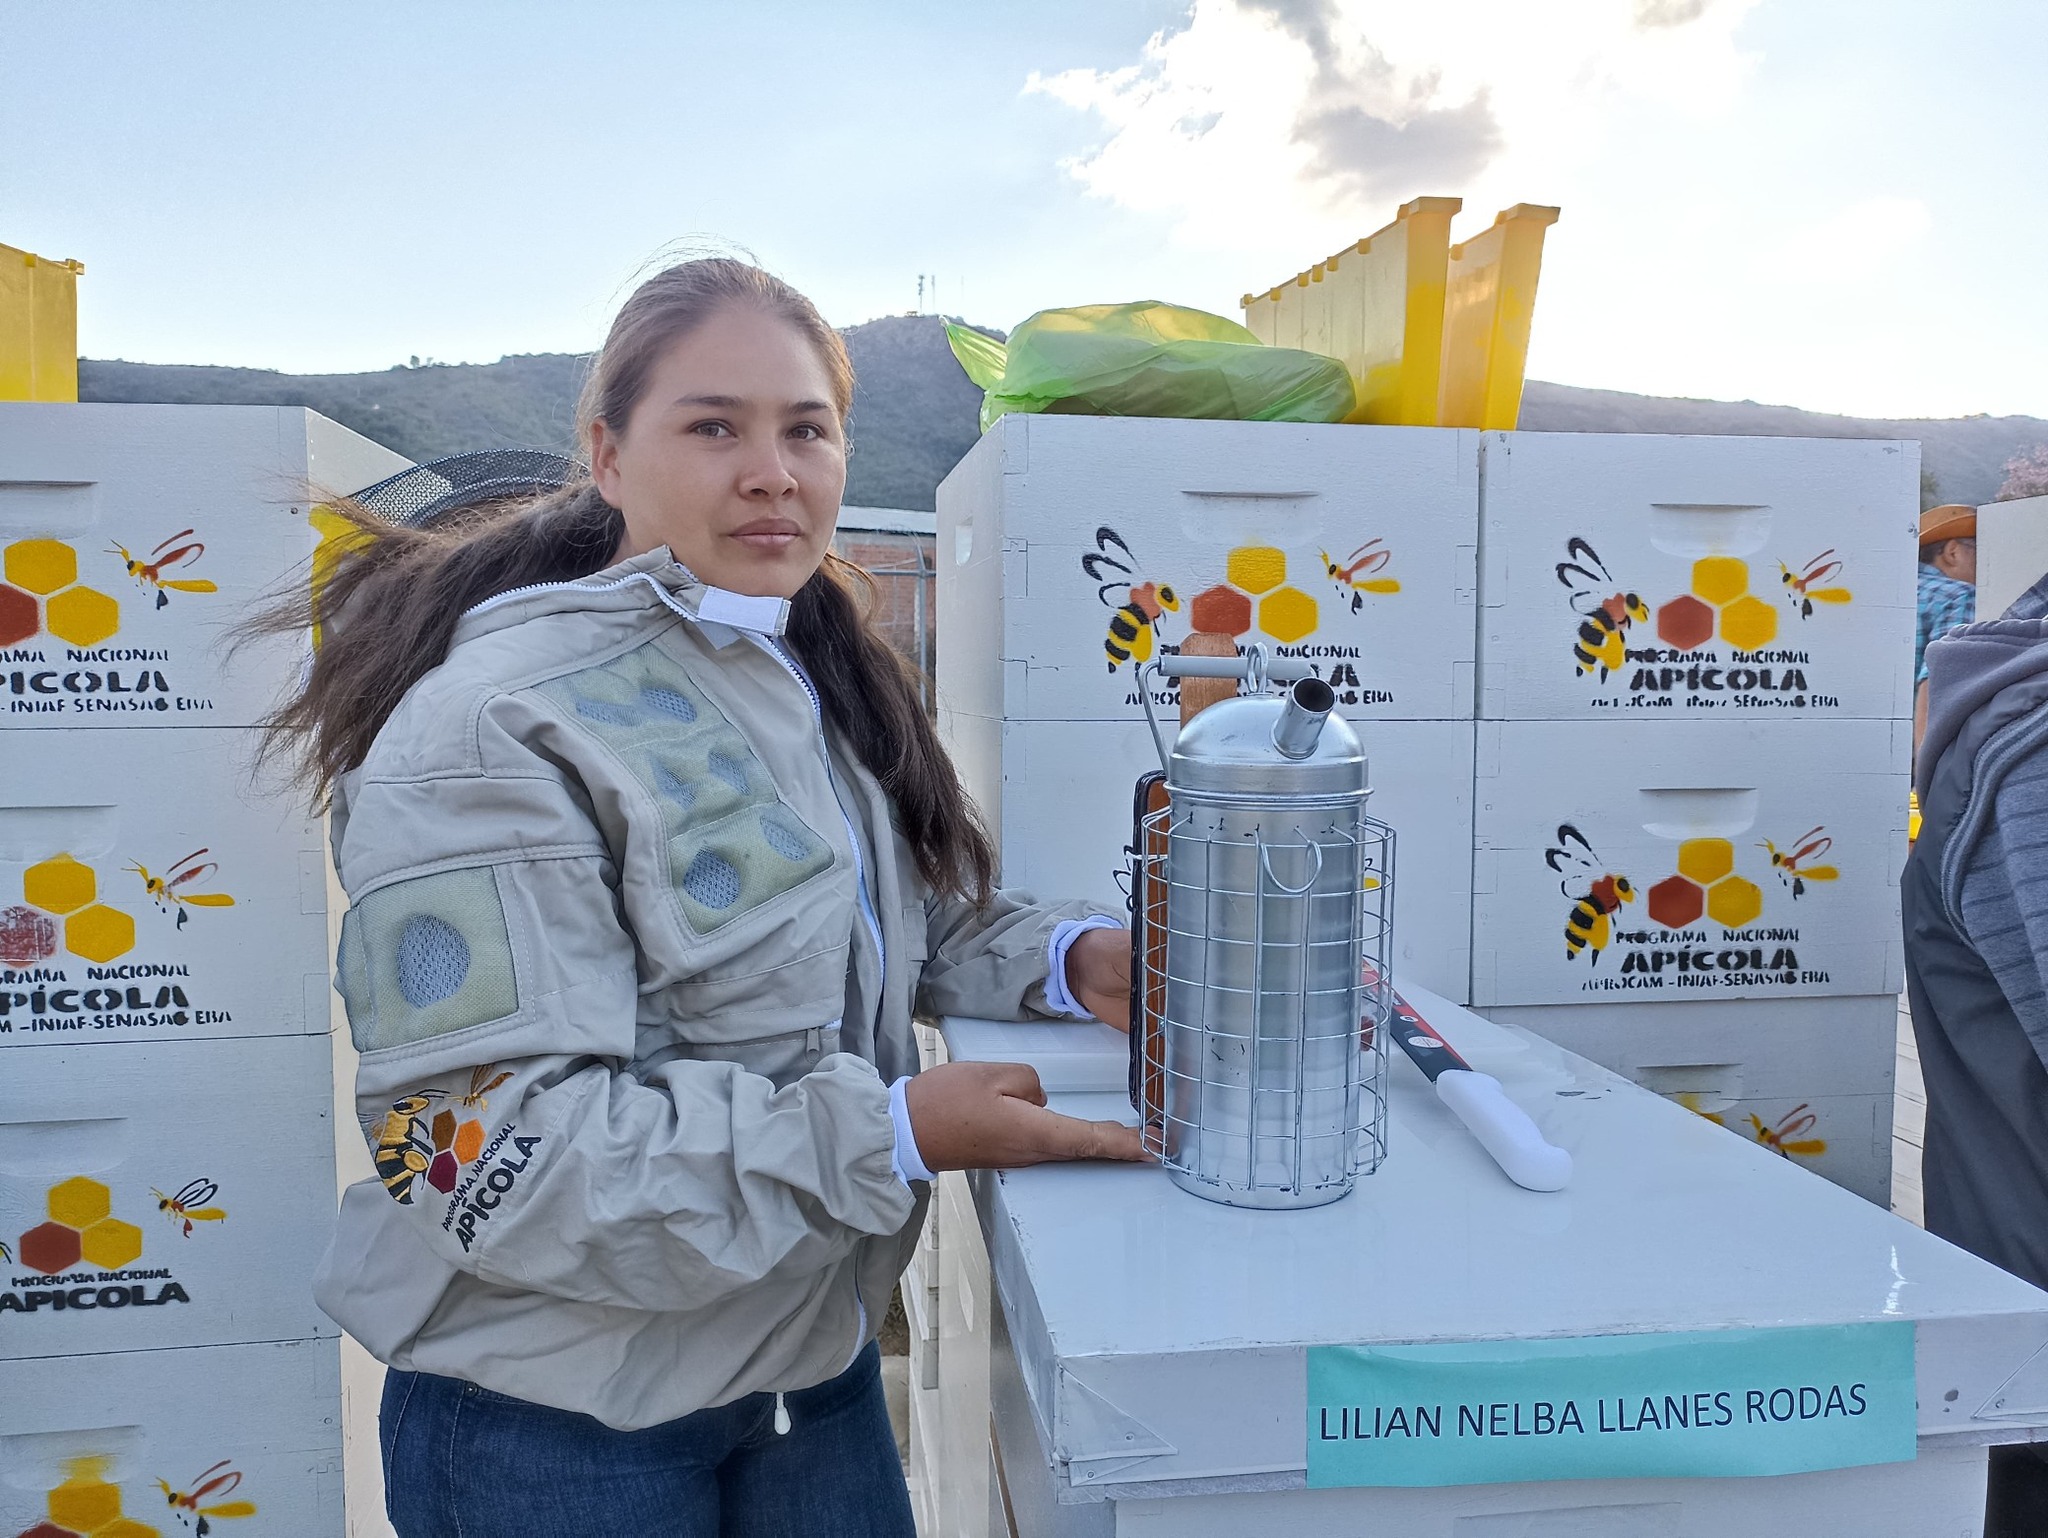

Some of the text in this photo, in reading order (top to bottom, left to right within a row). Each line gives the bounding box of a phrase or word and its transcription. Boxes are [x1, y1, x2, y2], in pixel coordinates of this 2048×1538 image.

[67, 649, 168, 662] NACIONAL
[1277, 645, 1361, 658] NACIONAL
[1625, 647, 1809, 664] PROGRAMA NACIONAL
[1616, 928, 1799, 944] PROGRAMA NACIONAL
[0, 965, 190, 985] RAMA NACIONAL
[442, 1123, 516, 1232] PROGRAMA NACIONAL
[98, 1268, 172, 1281] NACIONAL
[0, 1282, 190, 1314] APICOLA
[1322, 1384, 1866, 1440] LILIAN NELBA LLANES RODAS
